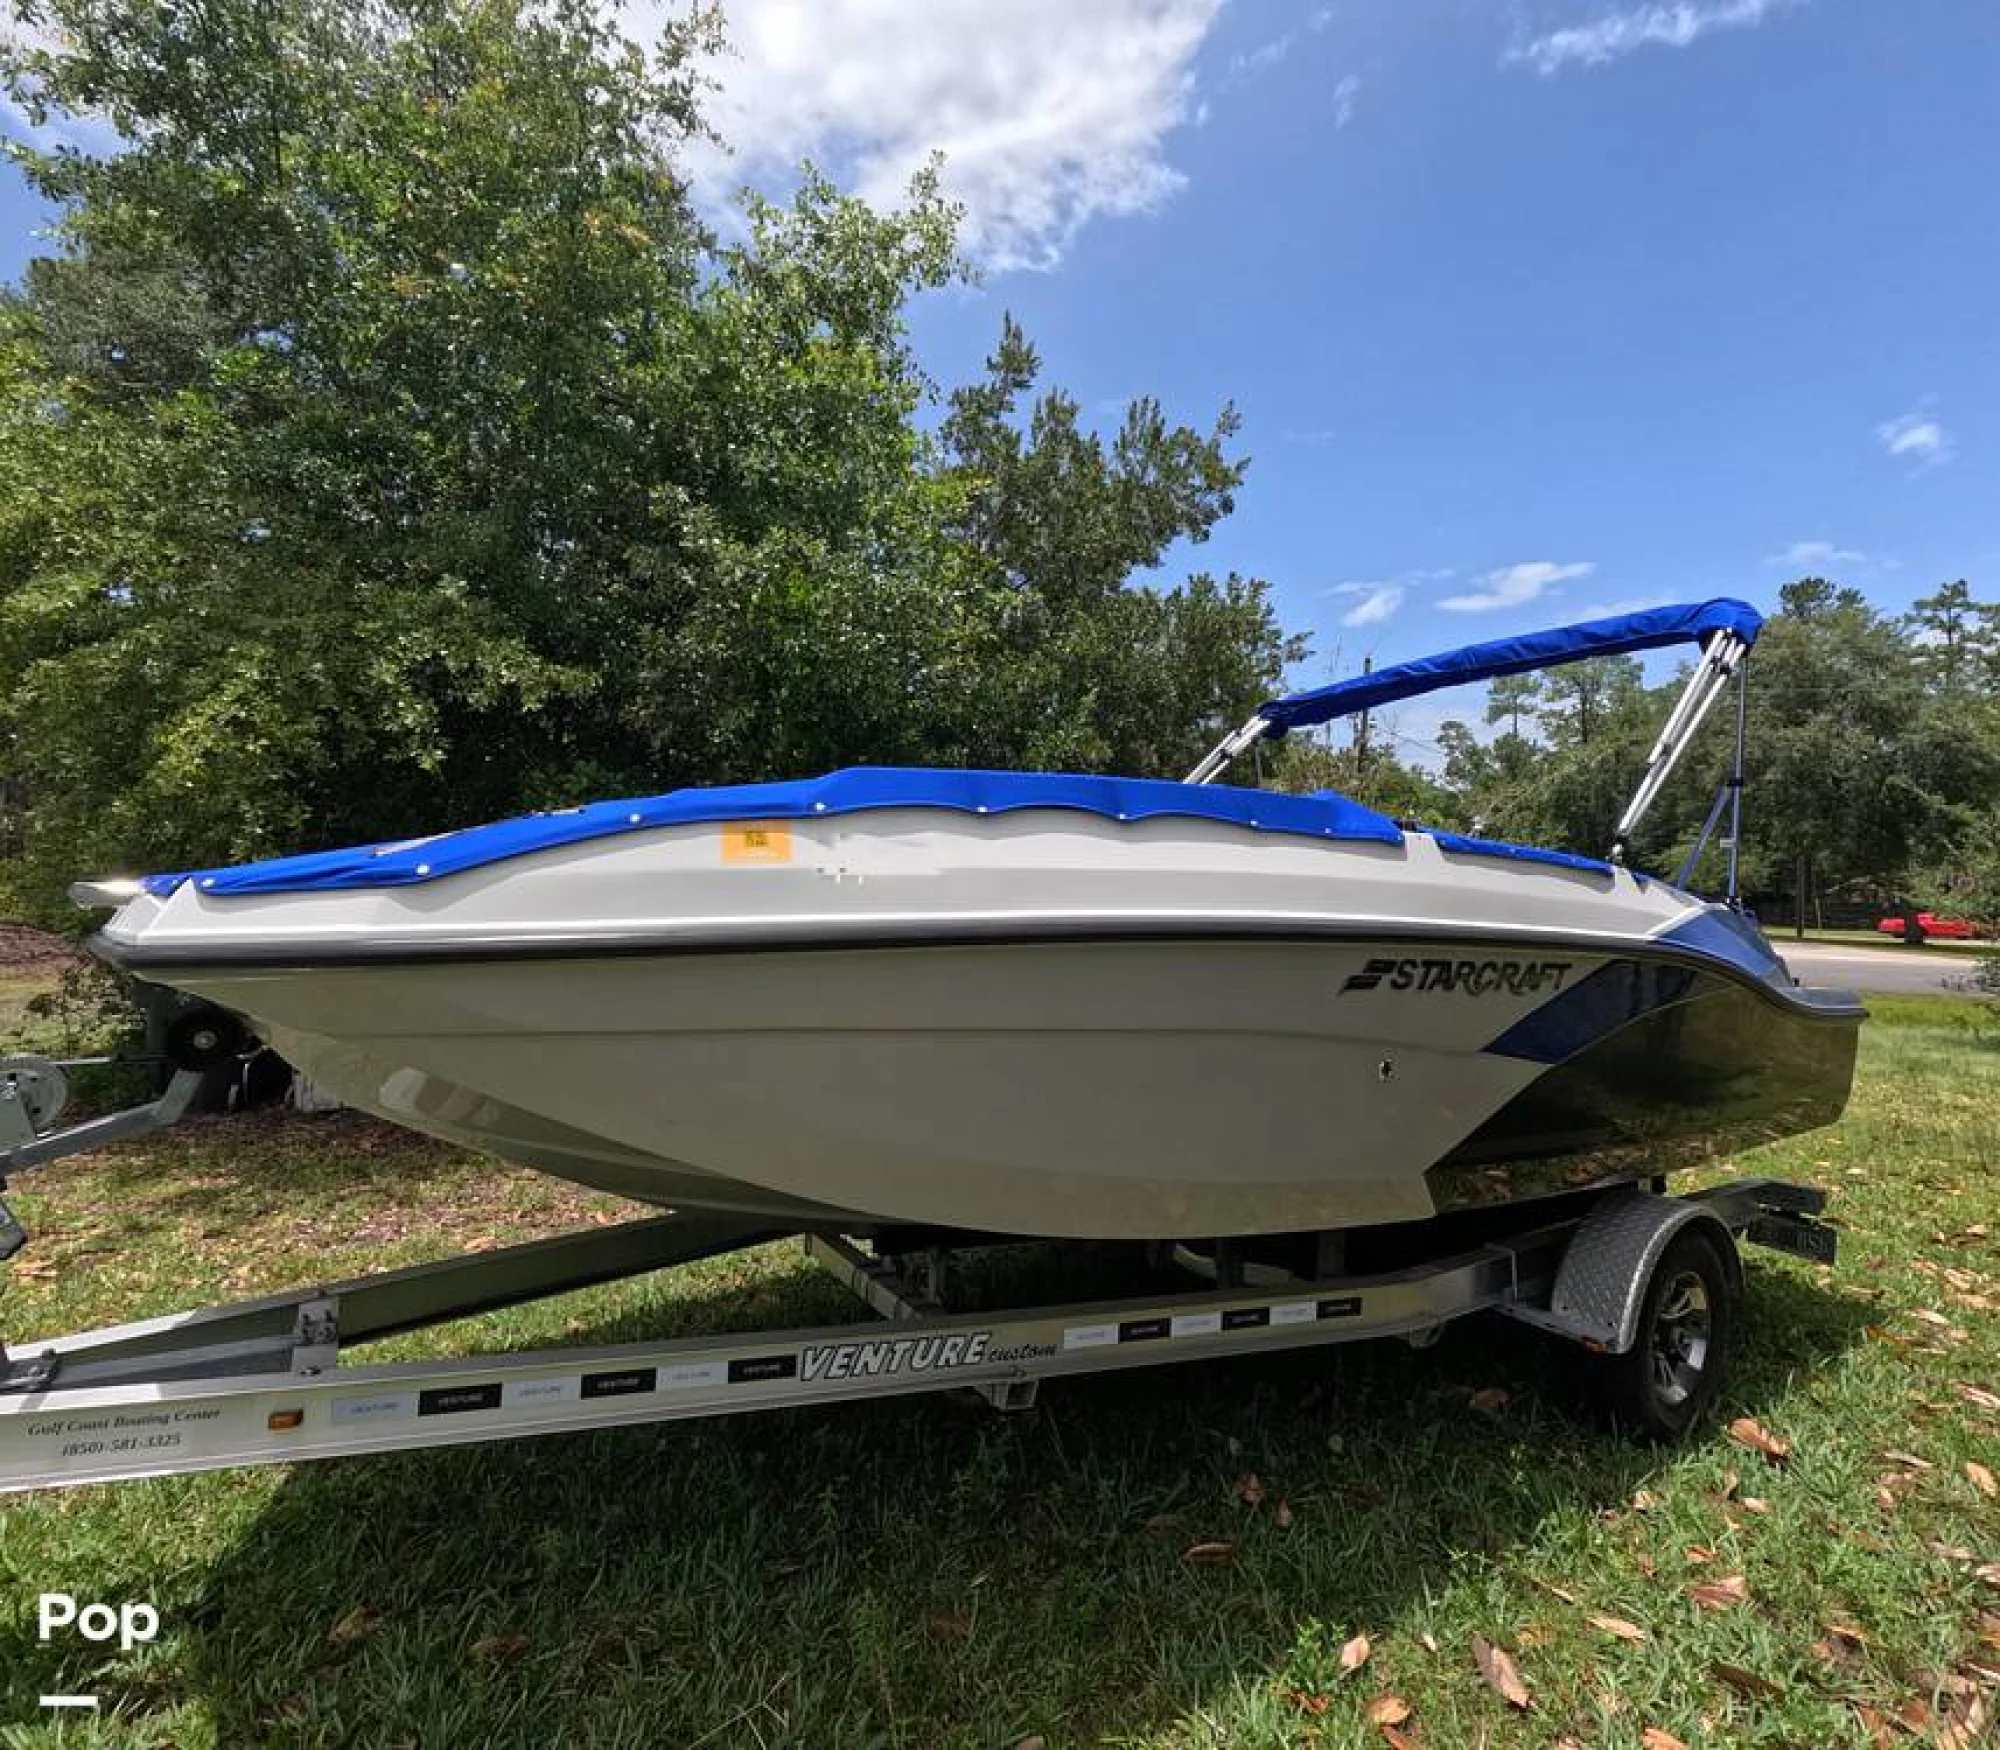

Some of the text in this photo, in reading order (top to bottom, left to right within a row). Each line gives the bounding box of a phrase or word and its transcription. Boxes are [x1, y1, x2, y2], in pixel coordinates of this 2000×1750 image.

[1390, 958, 1573, 997] STARCRAFT
[800, 1332, 1058, 1381] VENTURE custom
[174, 1410, 220, 1422] Center
